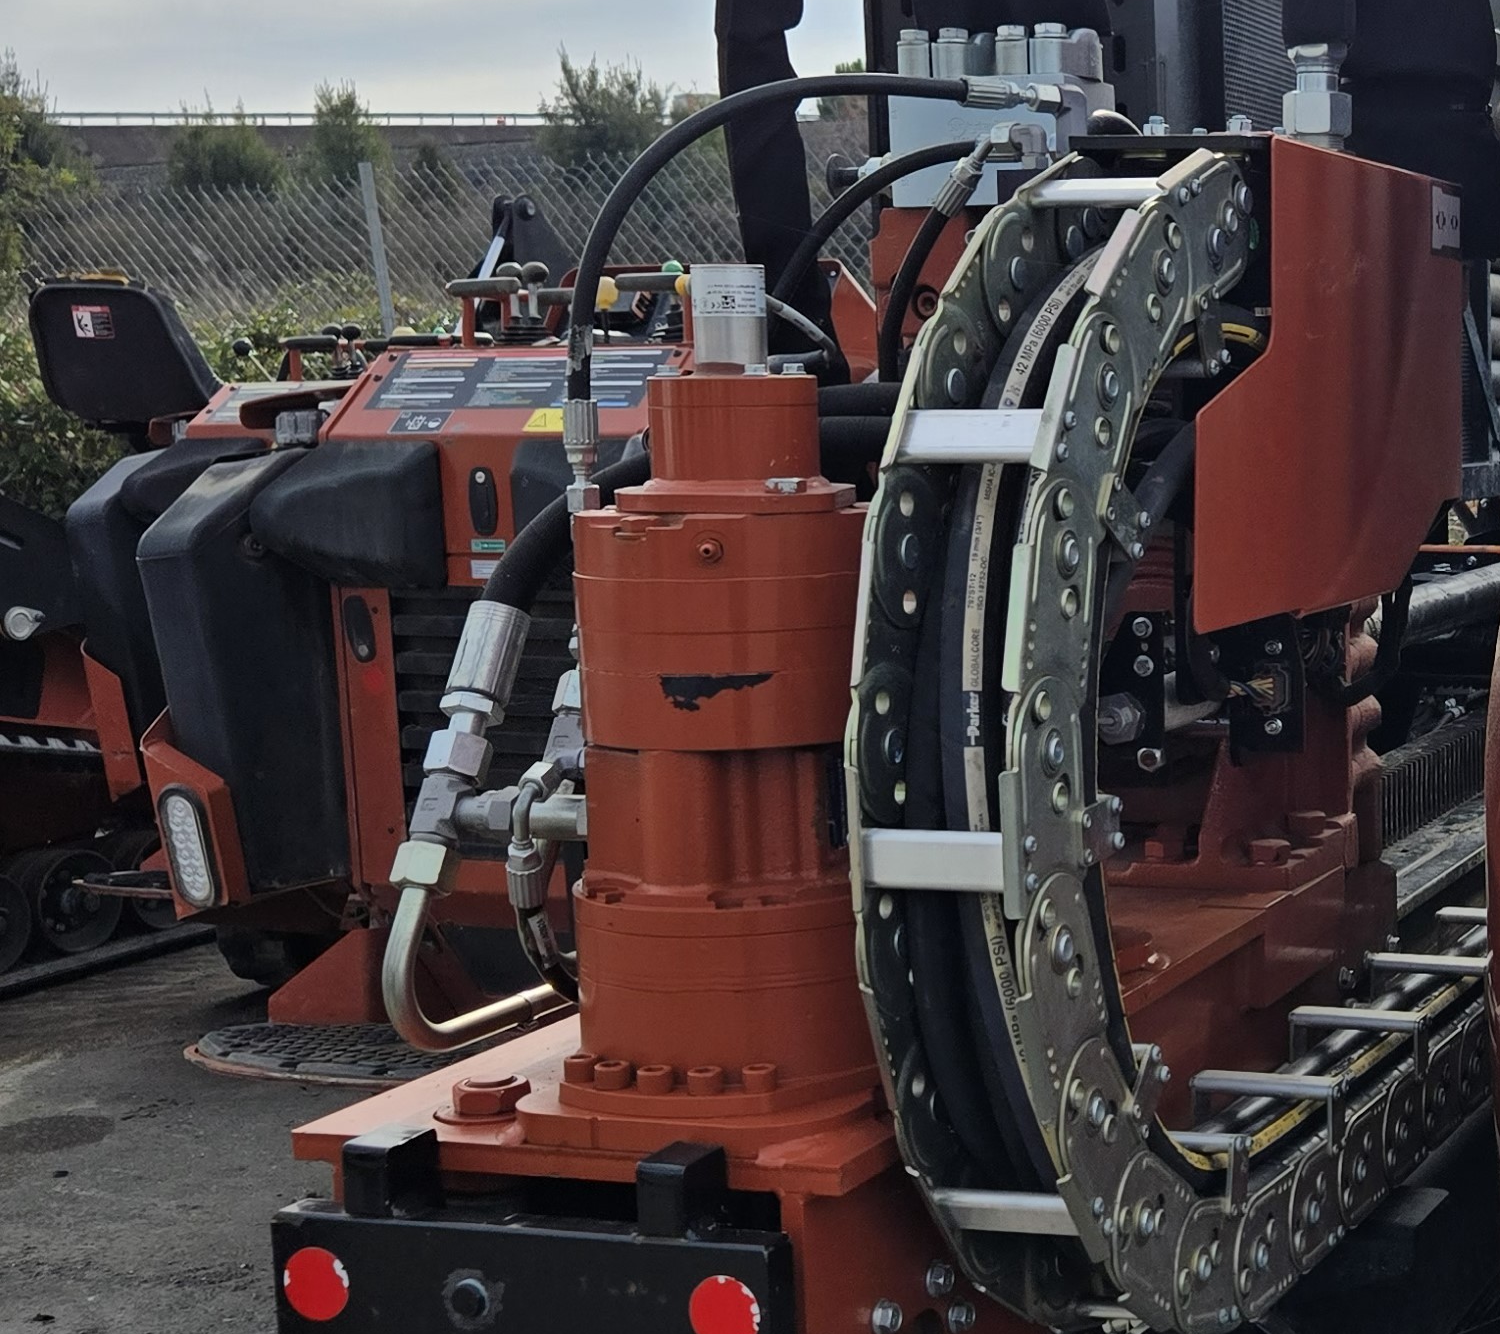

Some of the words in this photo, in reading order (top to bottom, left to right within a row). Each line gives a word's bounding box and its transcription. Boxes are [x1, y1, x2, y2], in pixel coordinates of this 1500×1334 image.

[1044, 298, 1064, 320] PSI)
[1030, 314, 1052, 340] (6000
[1024, 338, 1039, 363] MPa
[1015, 361, 1029, 376] 42
[970, 627, 981, 688] GLOBALCORE
[966, 692, 981, 737] Parker
[989, 934, 1009, 967] PSI)
